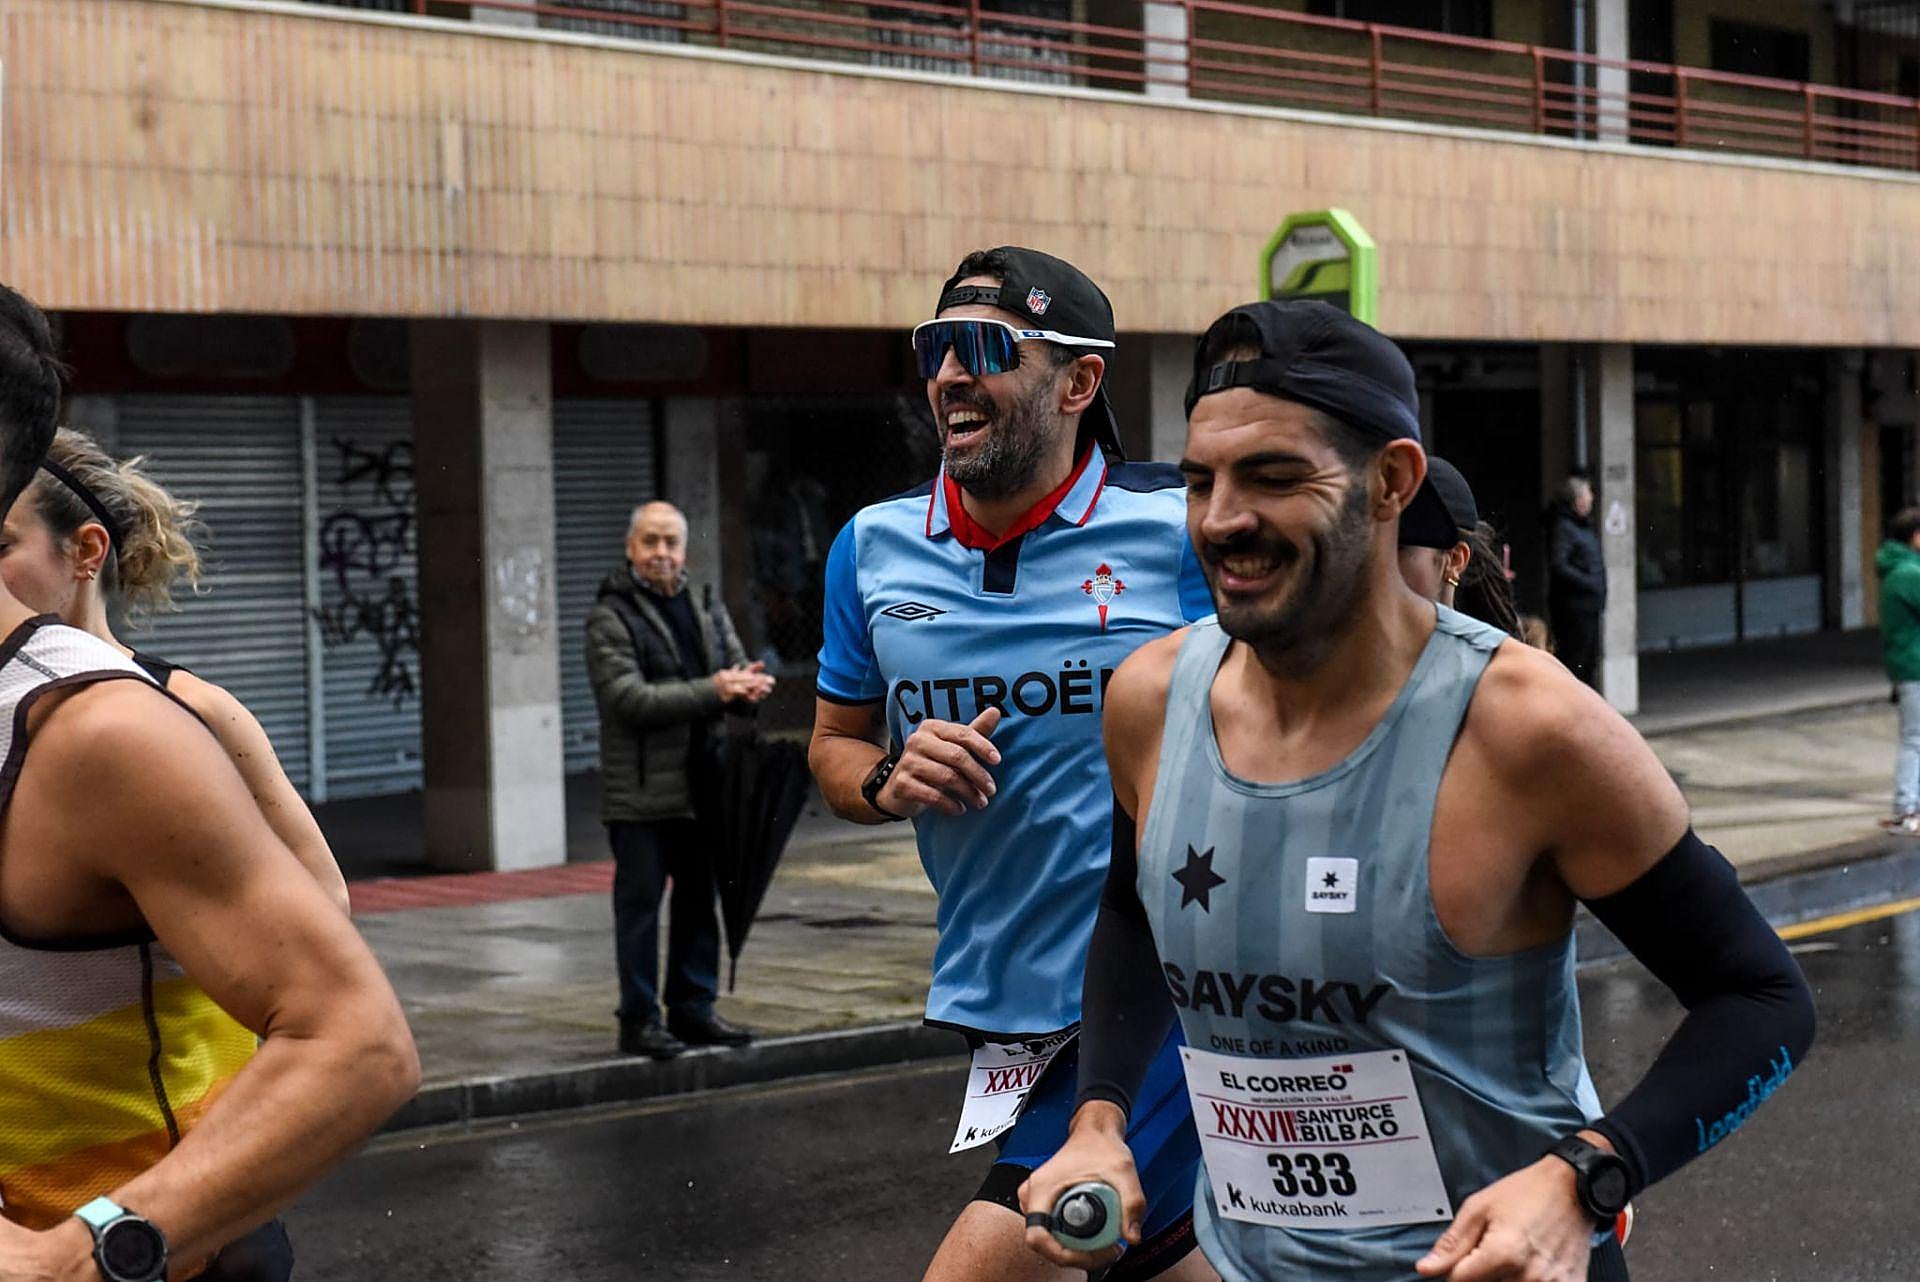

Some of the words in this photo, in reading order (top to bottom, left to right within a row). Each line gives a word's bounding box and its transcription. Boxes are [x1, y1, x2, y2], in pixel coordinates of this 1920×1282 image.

[1029, 295, 1046, 312] NFL
[1312, 891, 1348, 900] SAYSKY
[1163, 961, 1393, 1025] SAYSKY
[1210, 1035, 1245, 1053] ONE
[1250, 1040, 1274, 1055] OF
[1280, 1041, 1293, 1055] A
[1297, 1038, 1349, 1055] KIND
[1220, 1071, 1245, 1091] EL
[1247, 1074, 1348, 1093] CORREO
[1297, 1104, 1395, 1125] SANTURCE
[1300, 1120, 1399, 1142] BILBAO
[1267, 1152, 1357, 1198] 333
[1250, 1196, 1348, 1218] kutxabank
